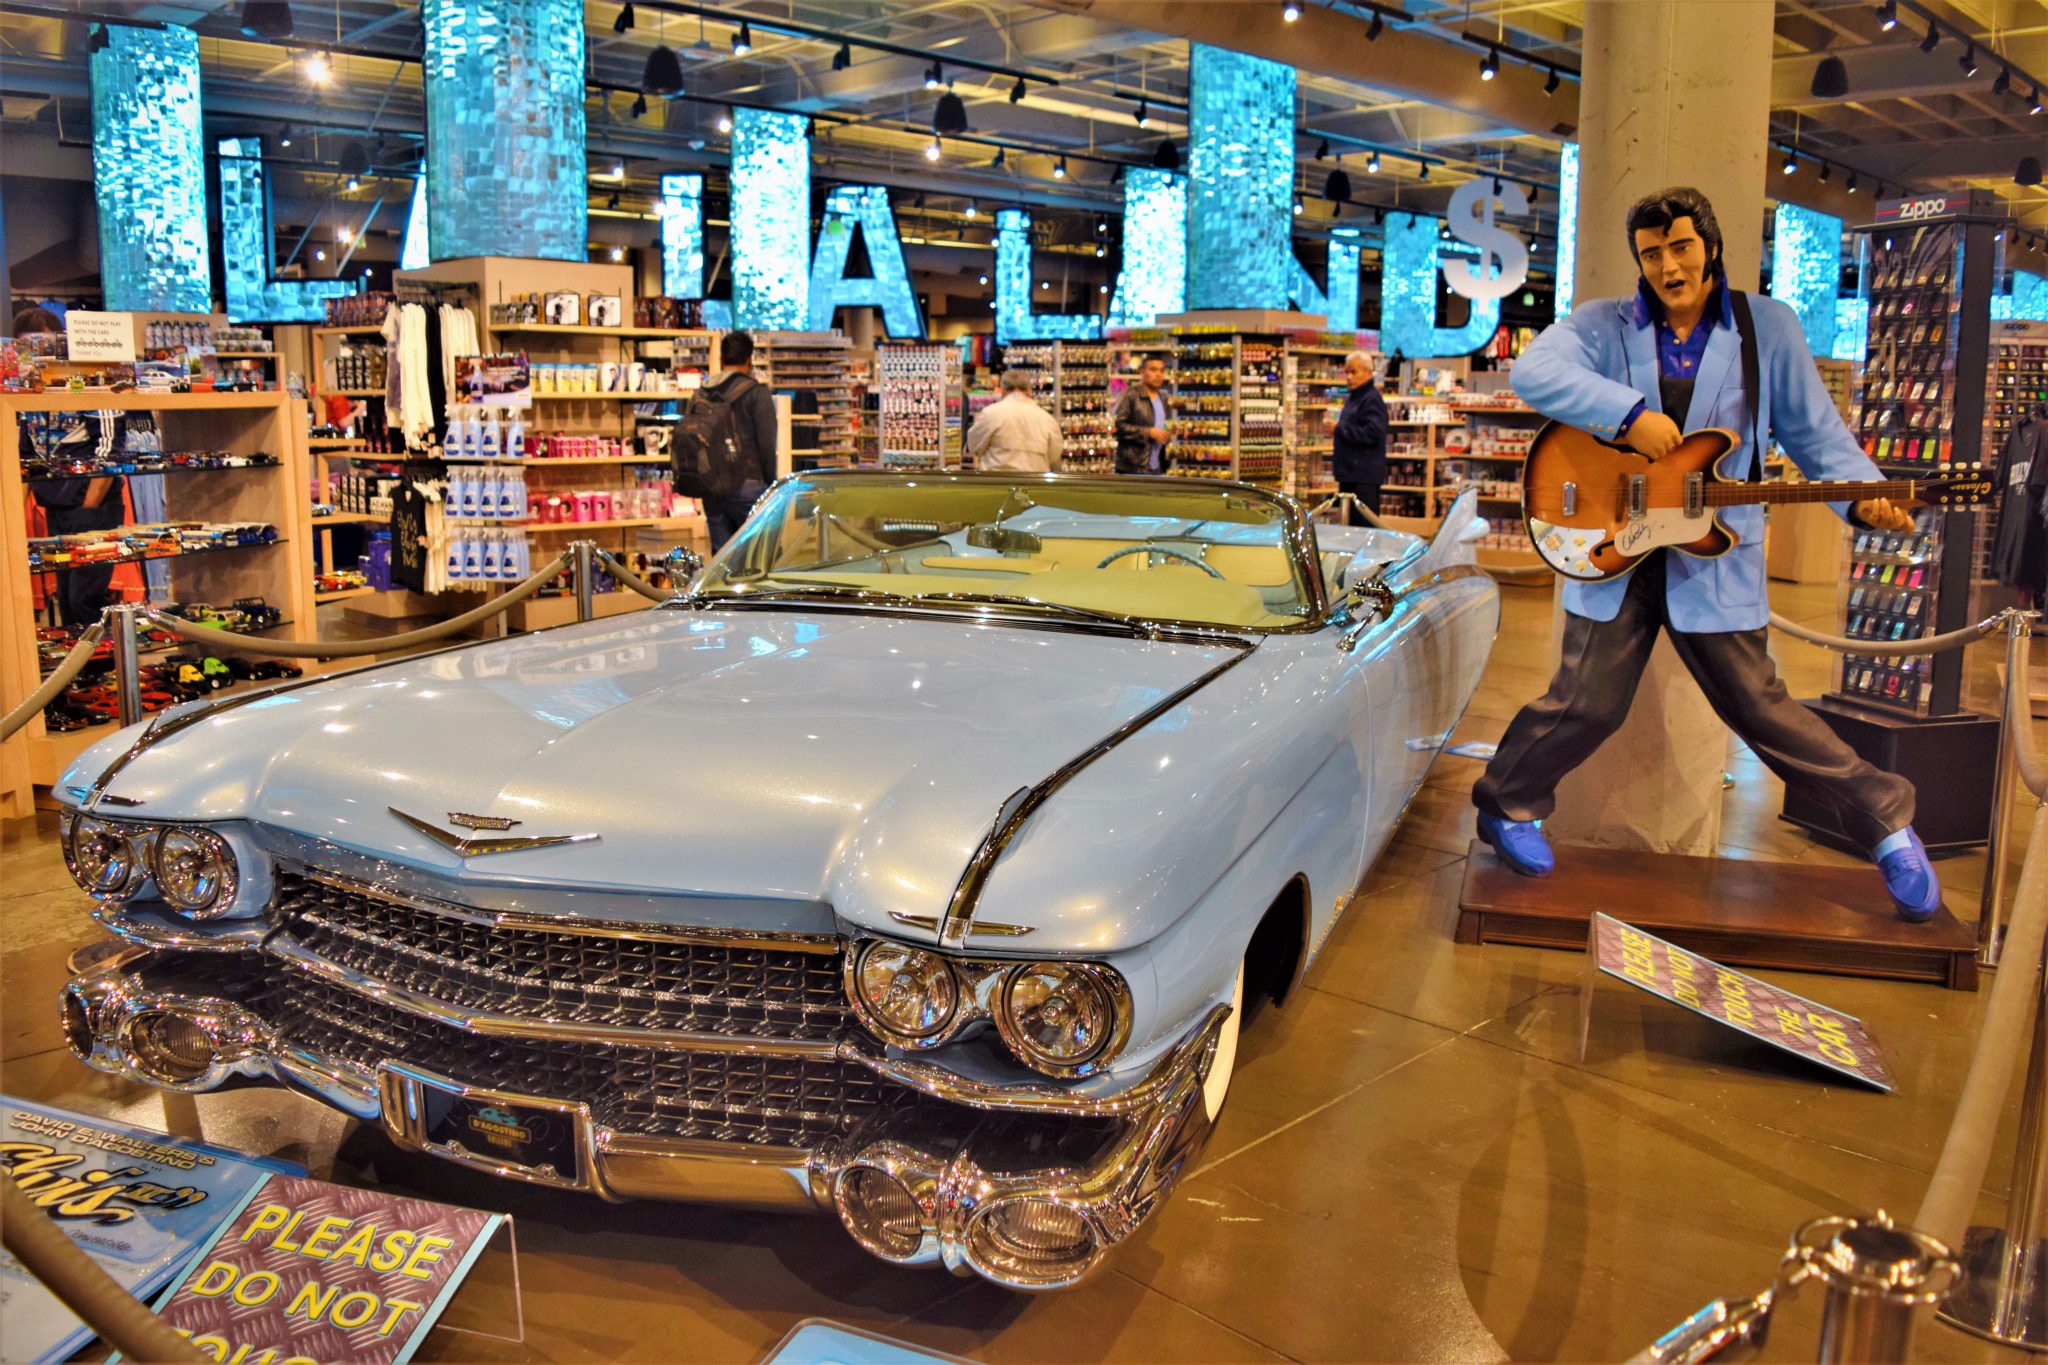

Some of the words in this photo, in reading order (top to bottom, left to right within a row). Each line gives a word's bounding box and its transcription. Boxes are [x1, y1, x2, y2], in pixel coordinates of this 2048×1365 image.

[1620, 928, 1656, 986] PLEASE
[1666, 945, 1697, 983] NOT
[1672, 979, 1701, 1009] DO
[1715, 967, 1757, 1030] TOUCH
[1774, 1004, 1806, 1040] THE
[1807, 1012, 1861, 1067] CAR
[10, 1120, 71, 1141] JOHN
[70, 1132, 198, 1171] D'AGOSTINO
[13, 1110, 76, 1131] DAVID
[100, 1131, 199, 1162] WALTERS
[198, 1155, 216, 1168] &
[239, 1204, 454, 1281] PLEASE
[189, 1259, 282, 1308] DO
[284, 1280, 423, 1338] NOT
